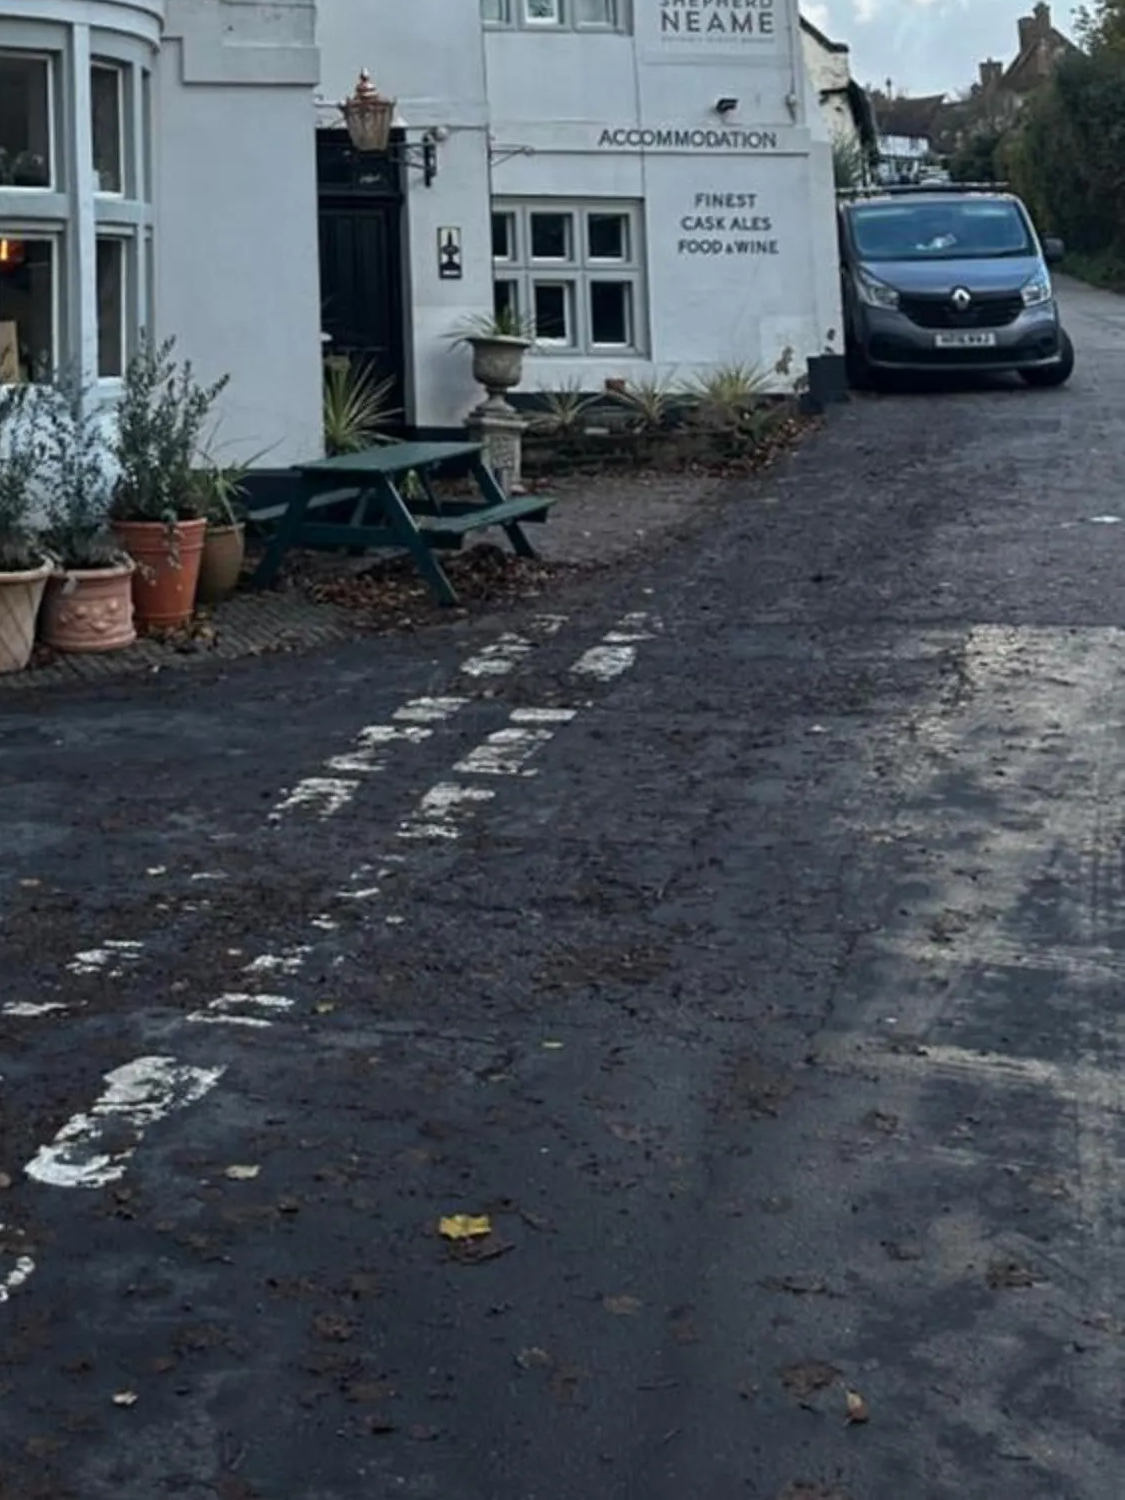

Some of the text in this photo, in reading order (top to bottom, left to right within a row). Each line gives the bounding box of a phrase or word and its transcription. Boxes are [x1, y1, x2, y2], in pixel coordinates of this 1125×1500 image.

[661, 10, 774, 34] NEAME
[598, 129, 777, 148] ACCOMMODATION
[695, 192, 757, 208] FINEST
[680, 216, 773, 231] CASK ALES
[678, 239, 723, 254] FOOD
[733, 240, 779, 255] WINE
